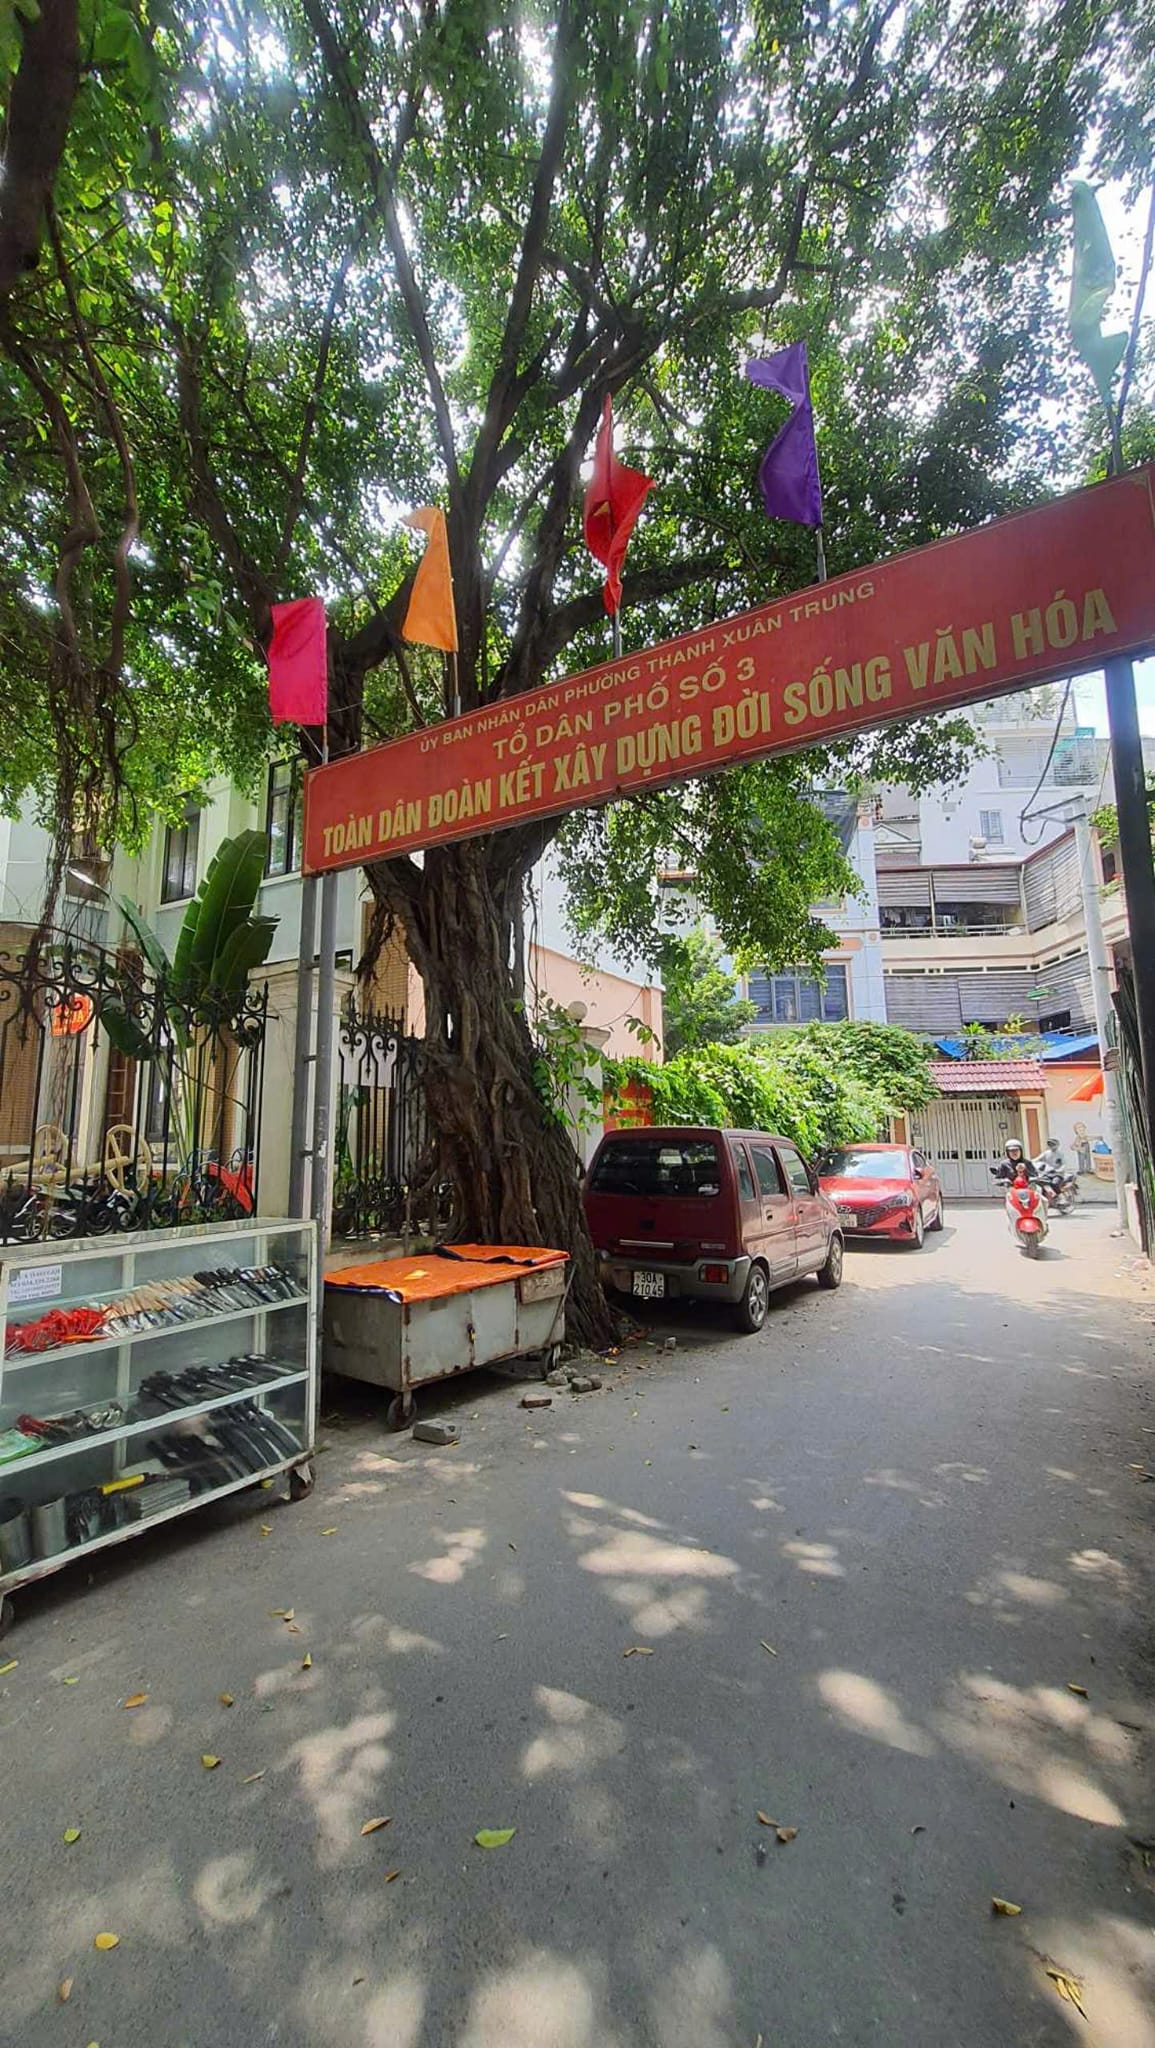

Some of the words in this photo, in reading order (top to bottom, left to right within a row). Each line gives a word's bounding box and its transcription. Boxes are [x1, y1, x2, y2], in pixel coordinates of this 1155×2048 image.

[420, 735, 440, 753] ỦY
[443, 725, 473, 746] BAN
[477, 708, 521, 733] NHÂN
[525, 696, 559, 718] DÂN
[565, 667, 641, 704] PHƯỜNG
[646, 639, 716, 675] THANH
[723, 615, 782, 649] XUÂN
[789, 581, 876, 621] TRUNG
[493, 722, 527, 760] TỔ
[535, 711, 593, 748] DÂN
[604, 676, 670, 726] PHỐ
[679, 656, 727, 700] SỐ
[737, 657, 755, 680] 3
[323, 814, 372, 857] TOÀN
[378, 798, 422, 841] DÂN
[428, 778, 491, 824] ĐOÀN
[499, 753, 545, 806] KẾT
[553, 741, 607, 793] XÂY
[616, 704, 702, 775] DỰNG
[712, 687, 771, 748] ĐỜI
[784, 655, 892, 726] SỐNG
[904, 622, 997, 690] VĂN
[1011, 588, 1118, 660] HÓA
[634, 1283, 663, 1296] 21045
[639, 1272, 657, 1283] 30A
